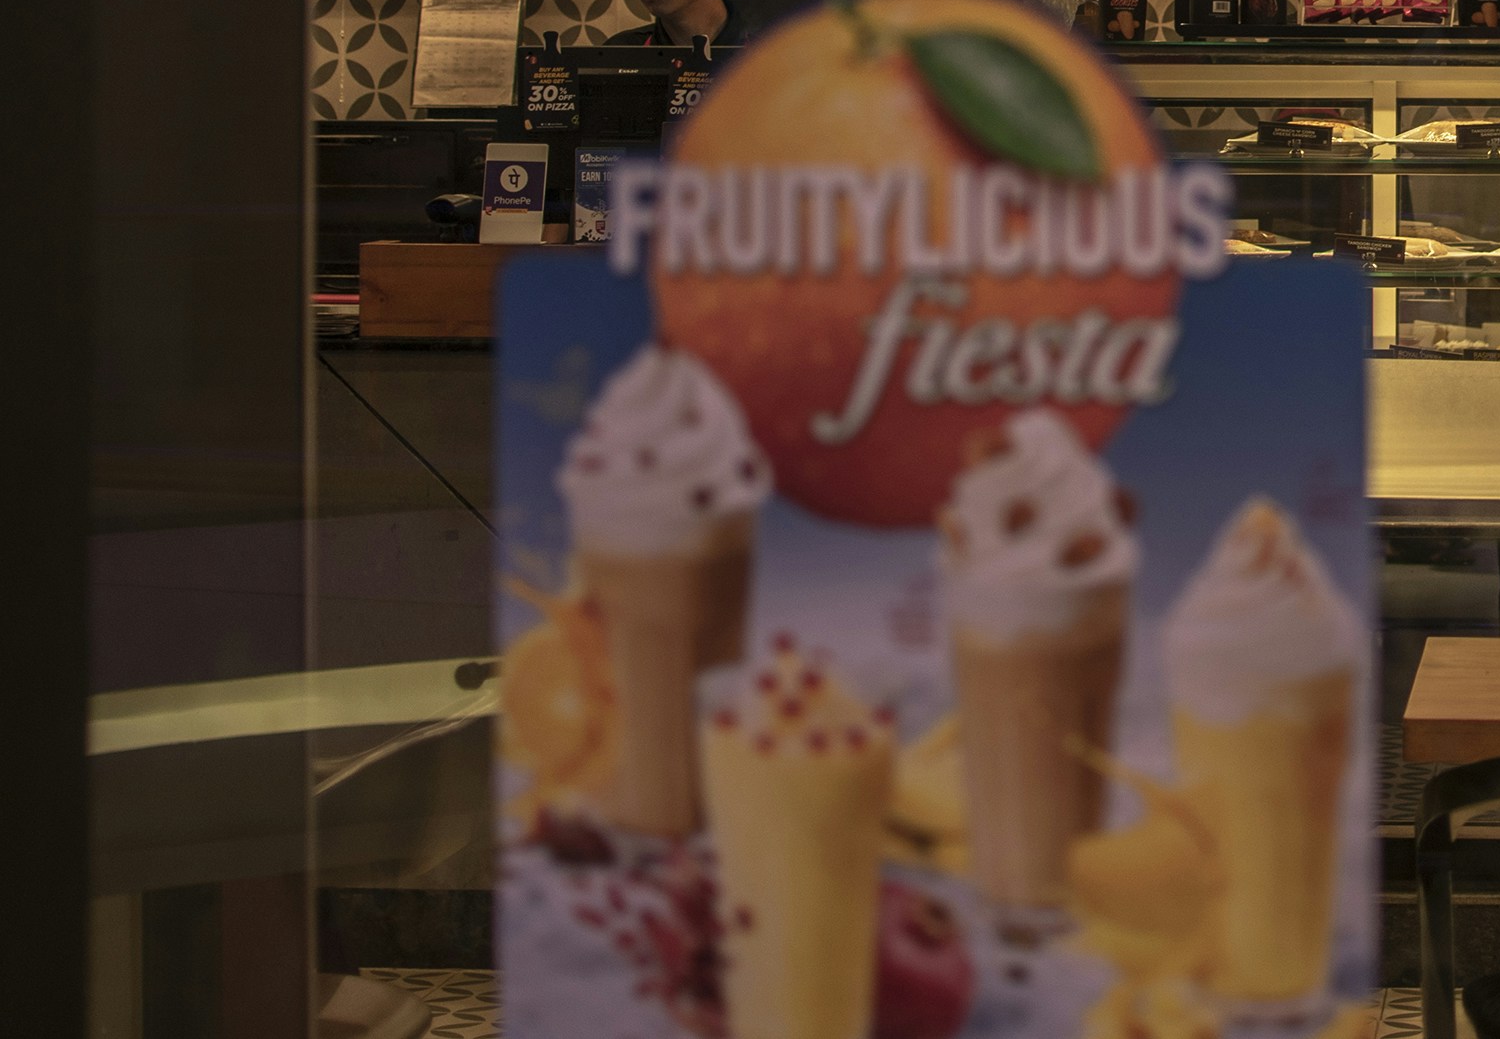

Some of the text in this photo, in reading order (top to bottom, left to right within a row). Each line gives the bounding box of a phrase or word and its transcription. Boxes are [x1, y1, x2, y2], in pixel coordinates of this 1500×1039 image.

[528, 103, 575, 111] ON PIZZA
[669, 107, 686, 115] ON
[581, 171, 601, 182] EARN
[494, 196, 531, 205] PhonePe
[606, 163, 1230, 278] FRUITYLICIOUS
[812, 280, 1180, 442] fiesta
